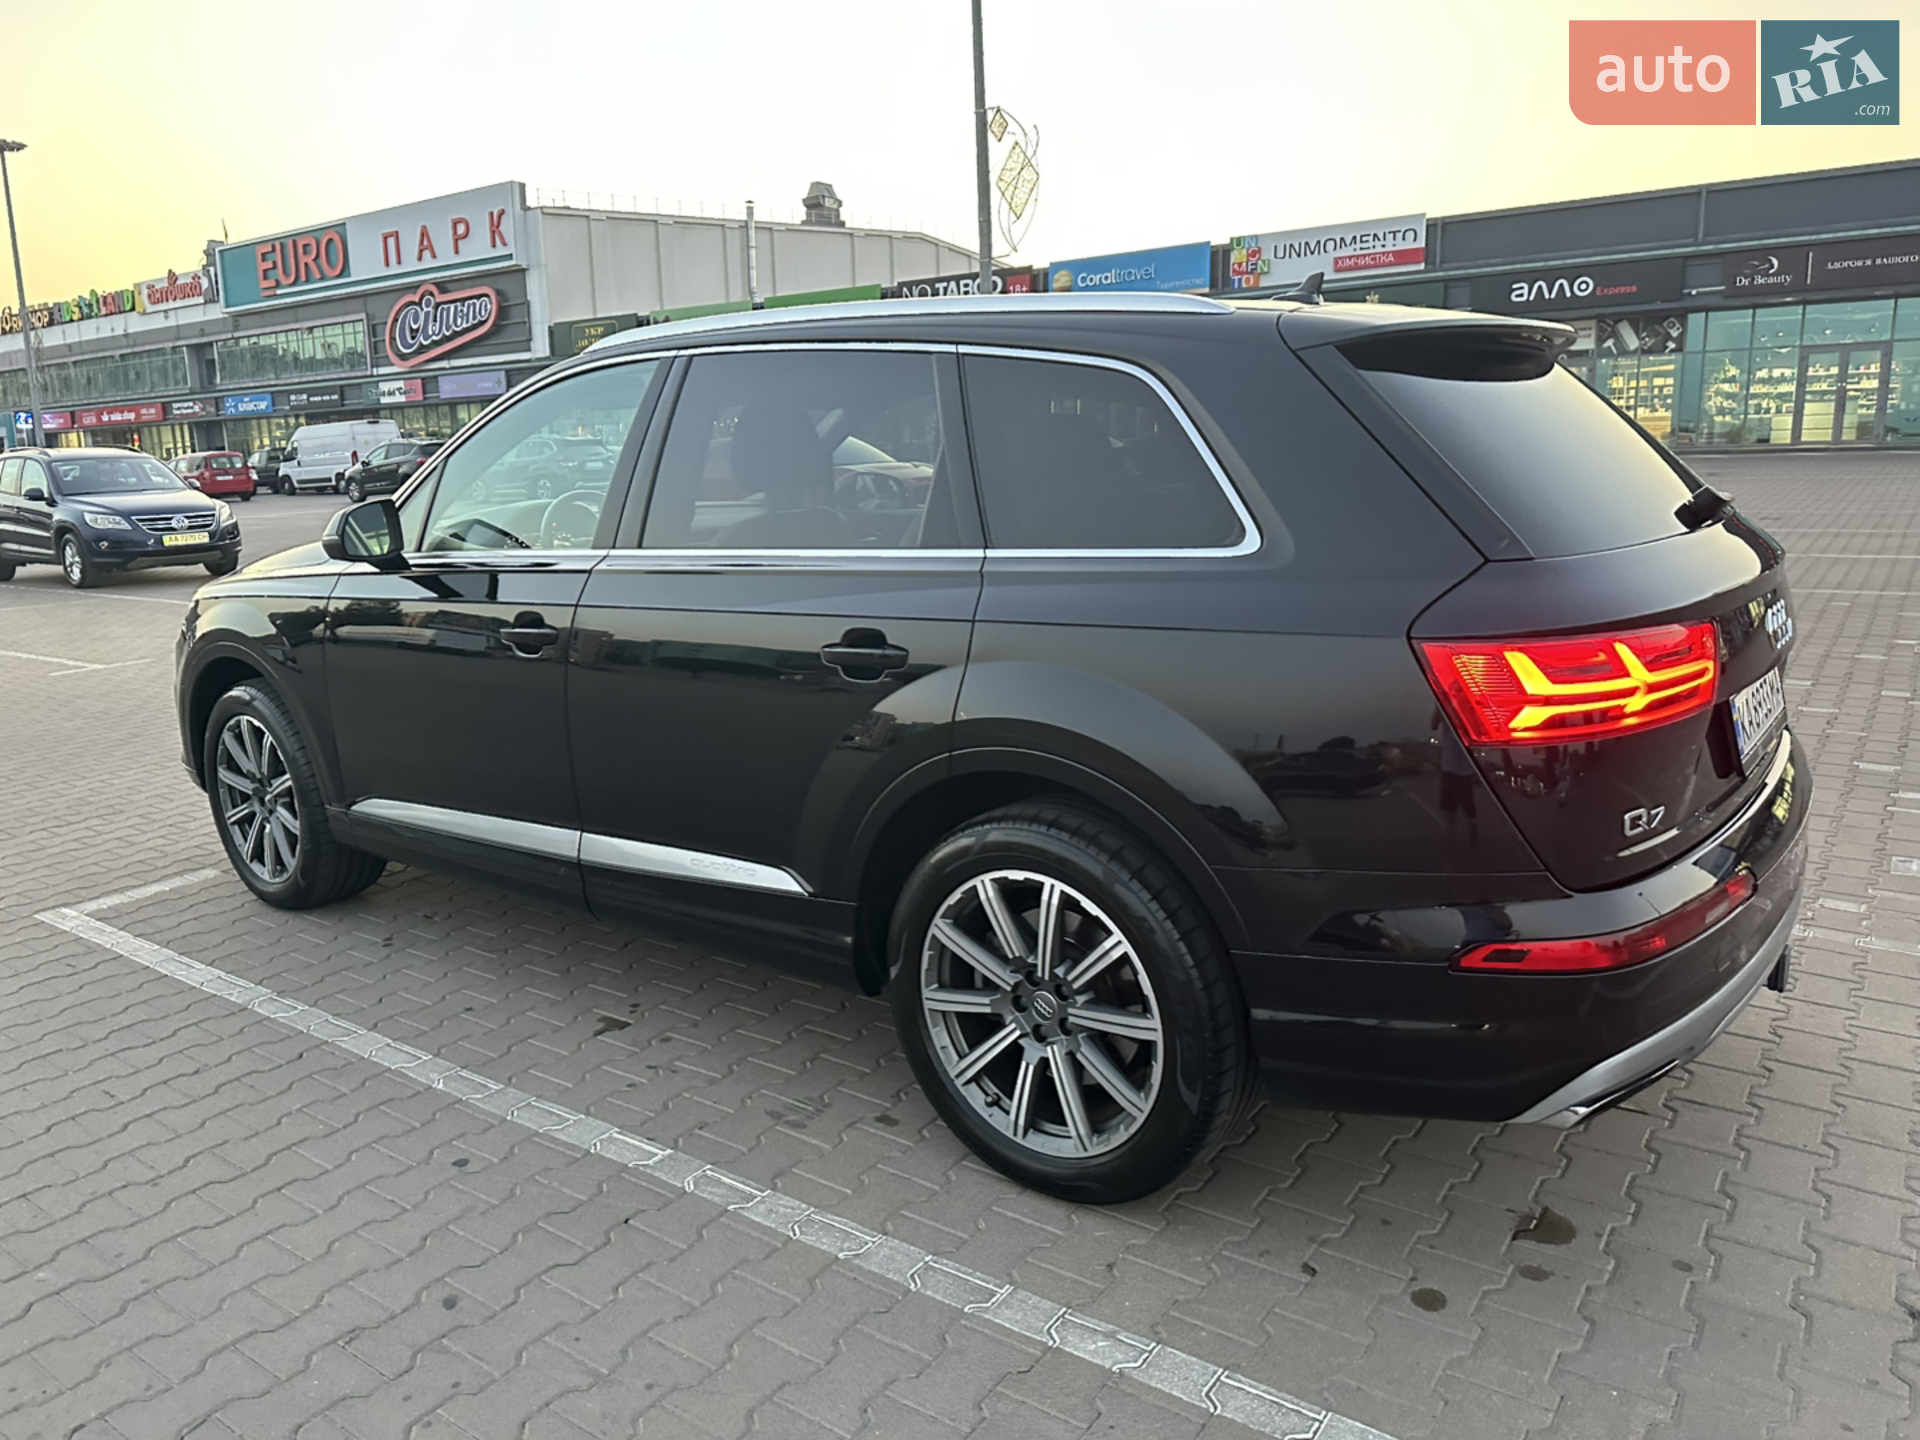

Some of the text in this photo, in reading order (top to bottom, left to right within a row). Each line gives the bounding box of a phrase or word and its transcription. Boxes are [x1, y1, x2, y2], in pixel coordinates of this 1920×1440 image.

[381, 207, 508, 268] ПАРК
[255, 229, 346, 289] EURO
[1336, 253, 1395, 268] ХІМЧИСТКА
[901, 283, 932, 299] NO
[1596, 284, 1638, 296] Express
[1736, 273, 1793, 286] Dr Beauty
[395, 294, 492, 354] Сільпо
[1624, 806, 1665, 836] Q7
